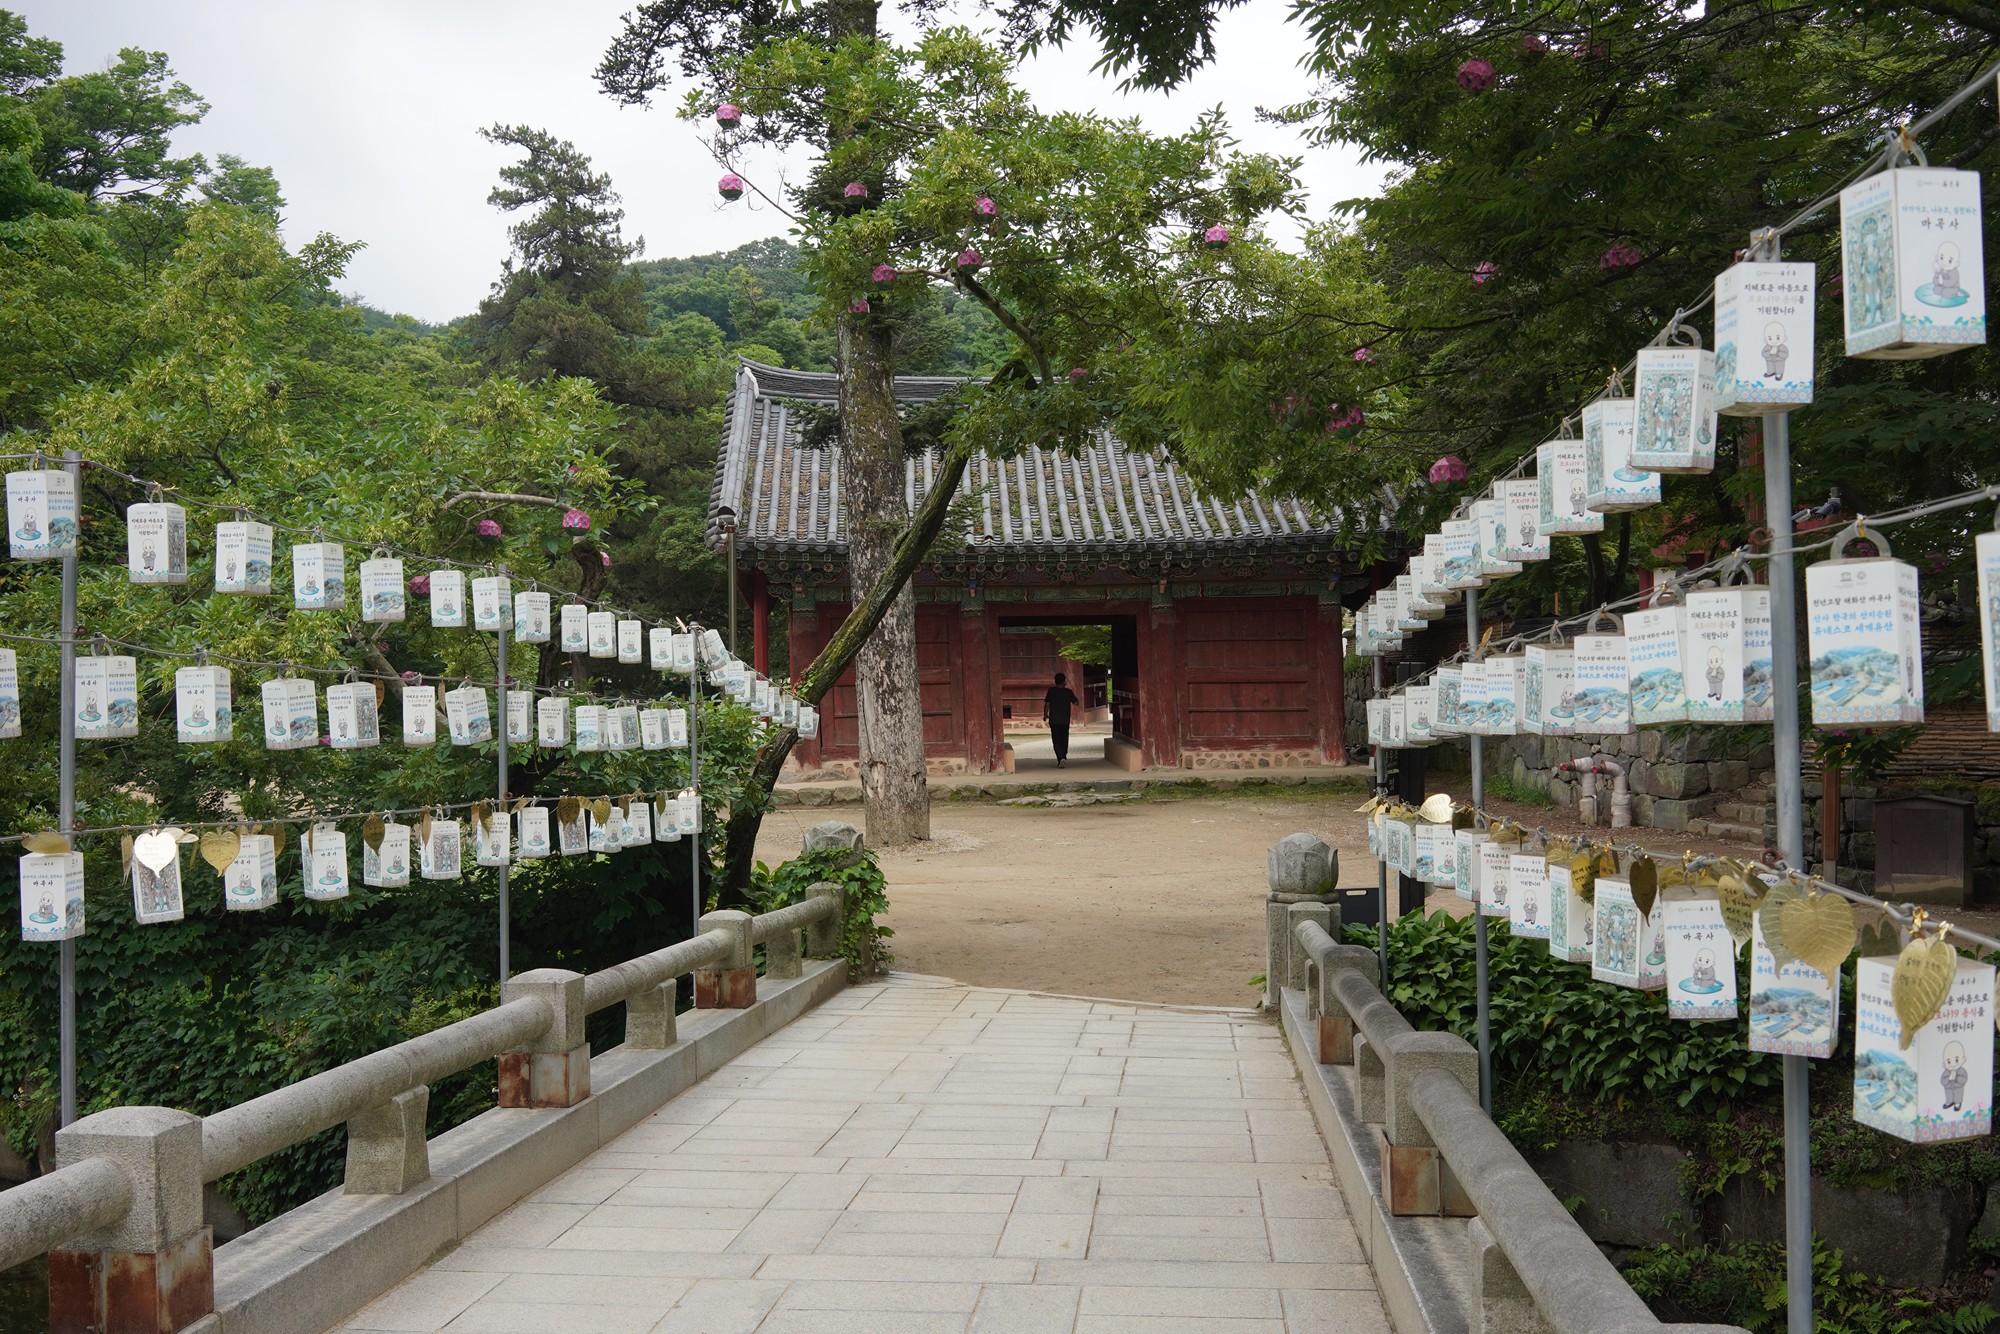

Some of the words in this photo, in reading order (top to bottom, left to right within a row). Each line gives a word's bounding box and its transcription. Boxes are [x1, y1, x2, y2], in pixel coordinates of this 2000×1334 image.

[1744, 283, 1775, 291] 지혜로운
[1777, 283, 1808, 292] 마음으로
[1757, 306, 1795, 315] 기원합니다
[1813, 597, 1841, 607] 천년고찰
[1844, 595, 1865, 604] 태화산
[1868, 594, 1891, 602] 마곡사
[1691, 611, 1711, 619] 지혜로운
[1714, 610, 1738, 618] 마음으로
[1814, 614, 1829, 622] 산사
[1833, 611, 1856, 621] 한국의
[1813, 624, 1851, 635] 유네스코
[1855, 621, 1893, 632] 세계유산
[1701, 631, 1728, 639] 기원합니다
[1683, 932, 1714, 941] 마곡사
[1957, 993, 1989, 1004] 마음으로
[1935, 1008, 1959, 1019] 로나19
[1961, 1006, 1984, 1018] 종식을
[1936, 1020, 1975, 1034] 기원합니다
